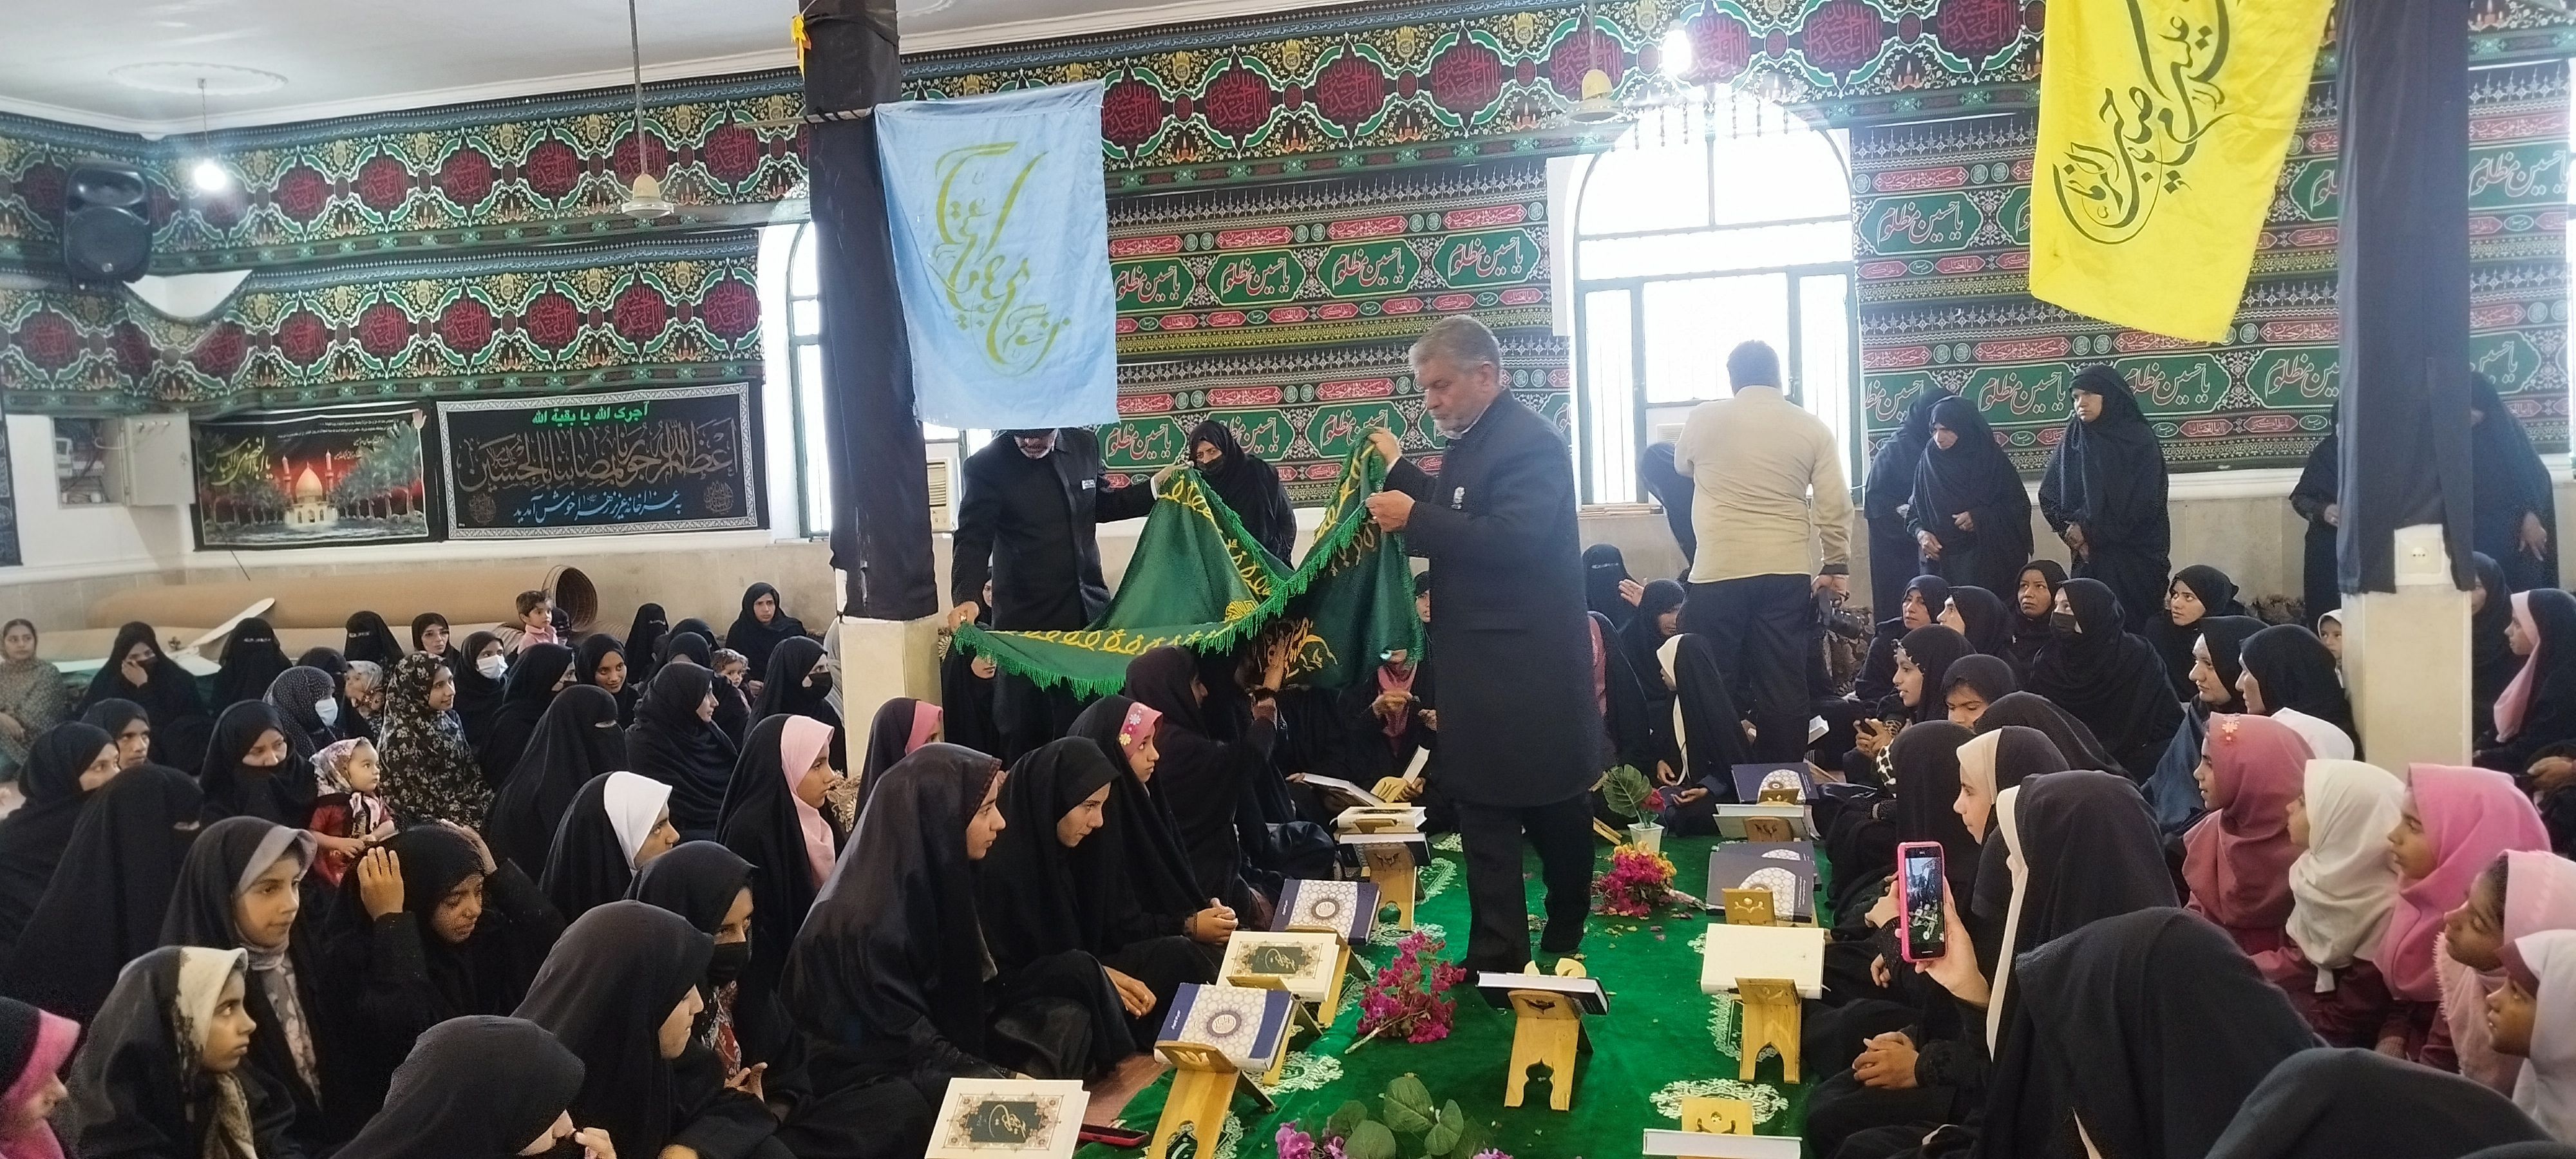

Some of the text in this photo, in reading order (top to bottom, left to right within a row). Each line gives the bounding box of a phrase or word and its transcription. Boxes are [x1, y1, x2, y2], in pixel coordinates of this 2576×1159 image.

[2505, 150, 2566, 197] حسین
[1877, 202, 1921, 247] مظلوم
[1909, 200, 1960, 244] حسین
[1949, 200, 1964, 241] یا
[1221, 257, 1290, 298] یا حسین مظلوم
[1333, 247, 1405, 290] یا حسین مظلوم
[1448, 236, 1523, 280] یا حسین مظلوم
[1139, 265, 1177, 303] حسین
[1170, 265, 1180, 300] یا
[2265, 353, 2314, 399] مظلوم
[2502, 341, 2518, 383] یا
[1978, 372, 2065, 415] یا حسین مظلوم
[2152, 363, 2206, 405] حسین
[2196, 363, 2210, 404] یا
[532, 410, 547, 425] الله
[580, 408, 591, 427] یا
[594, 406, 611, 420] الله
[1320, 410, 1356, 450] مظلوم
[1106, 423, 1171, 462] یا حسین مظلوم
[1239, 417, 1276, 455] حسین
[1270, 416, 1280, 453] یا
[265, 455, 274, 480] یا
[513, 493, 544, 524] آمدید
[535, 489, 576, 524] خوش
